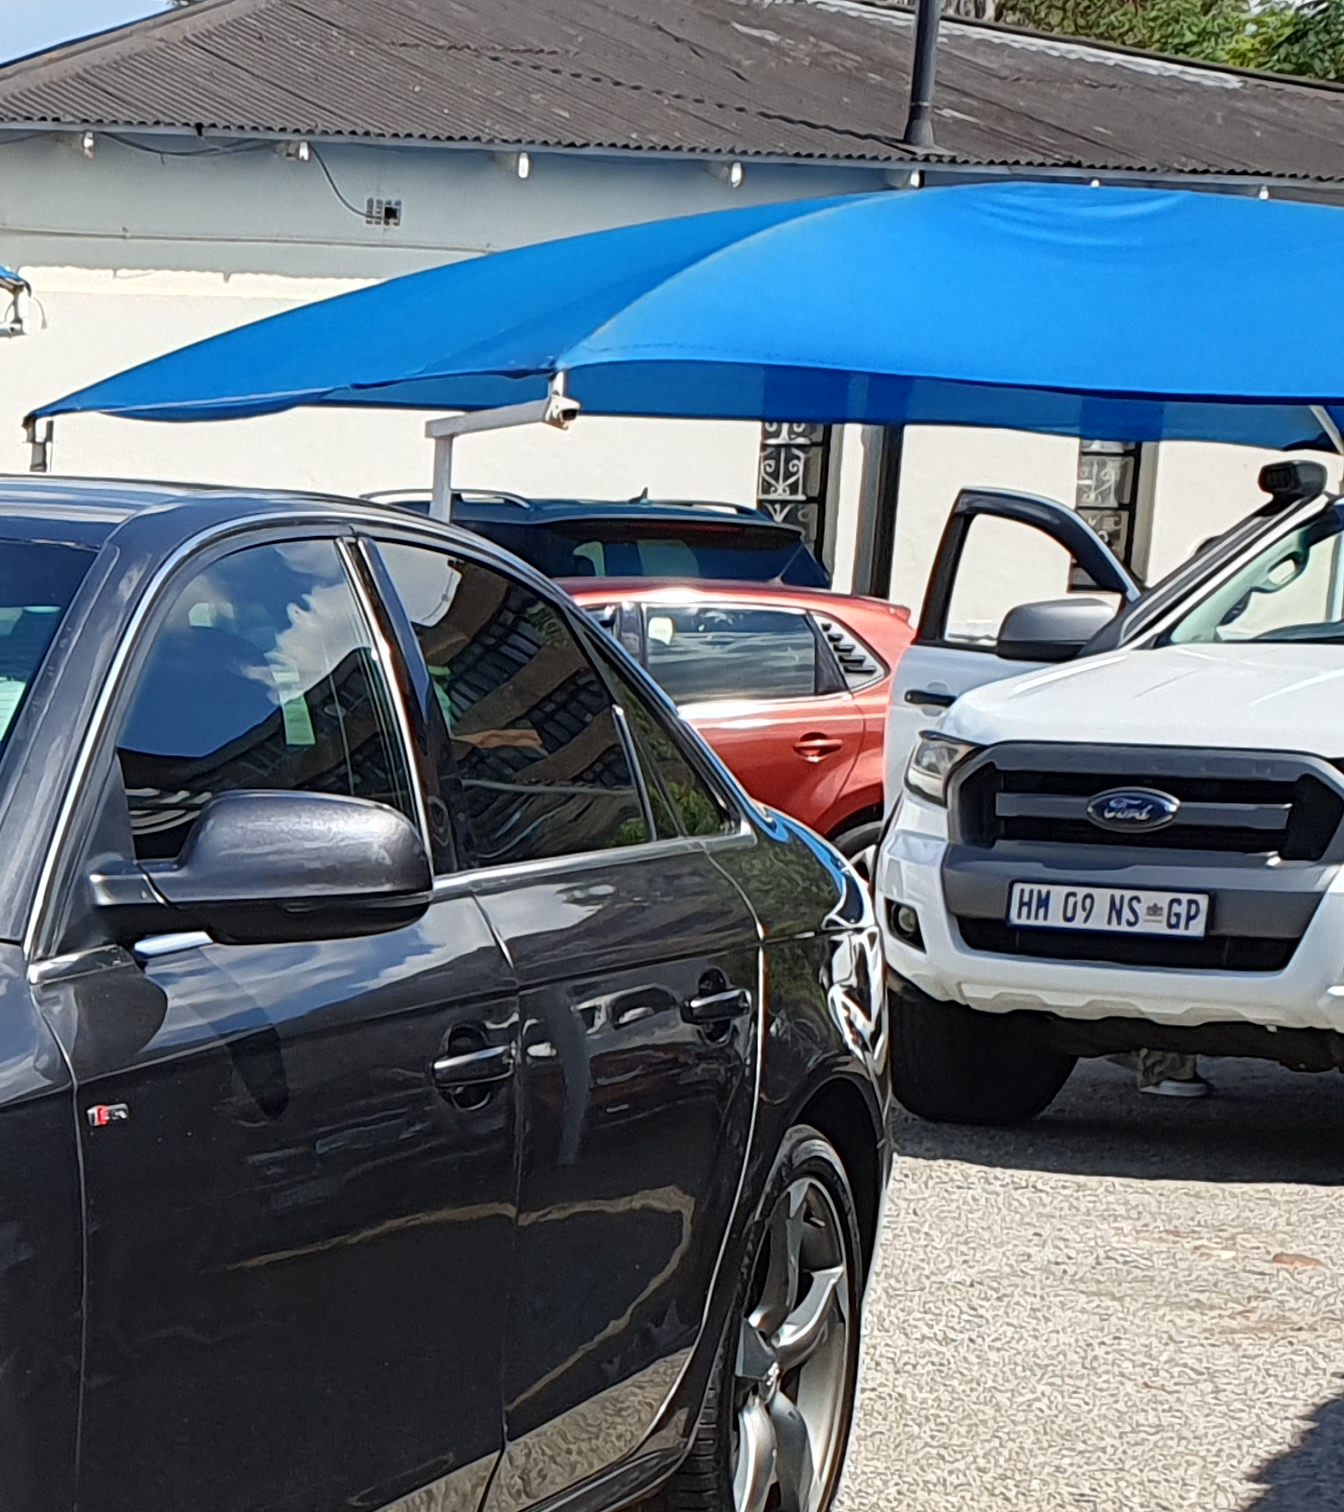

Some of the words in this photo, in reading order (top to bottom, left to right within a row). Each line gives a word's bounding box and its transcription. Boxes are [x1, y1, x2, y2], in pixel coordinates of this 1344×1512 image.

[1103, 797, 1154, 821] Ford
[1062, 891, 1095, 924] 09
[1107, 893, 1142, 927] NS
[1166, 897, 1201, 931] GP
